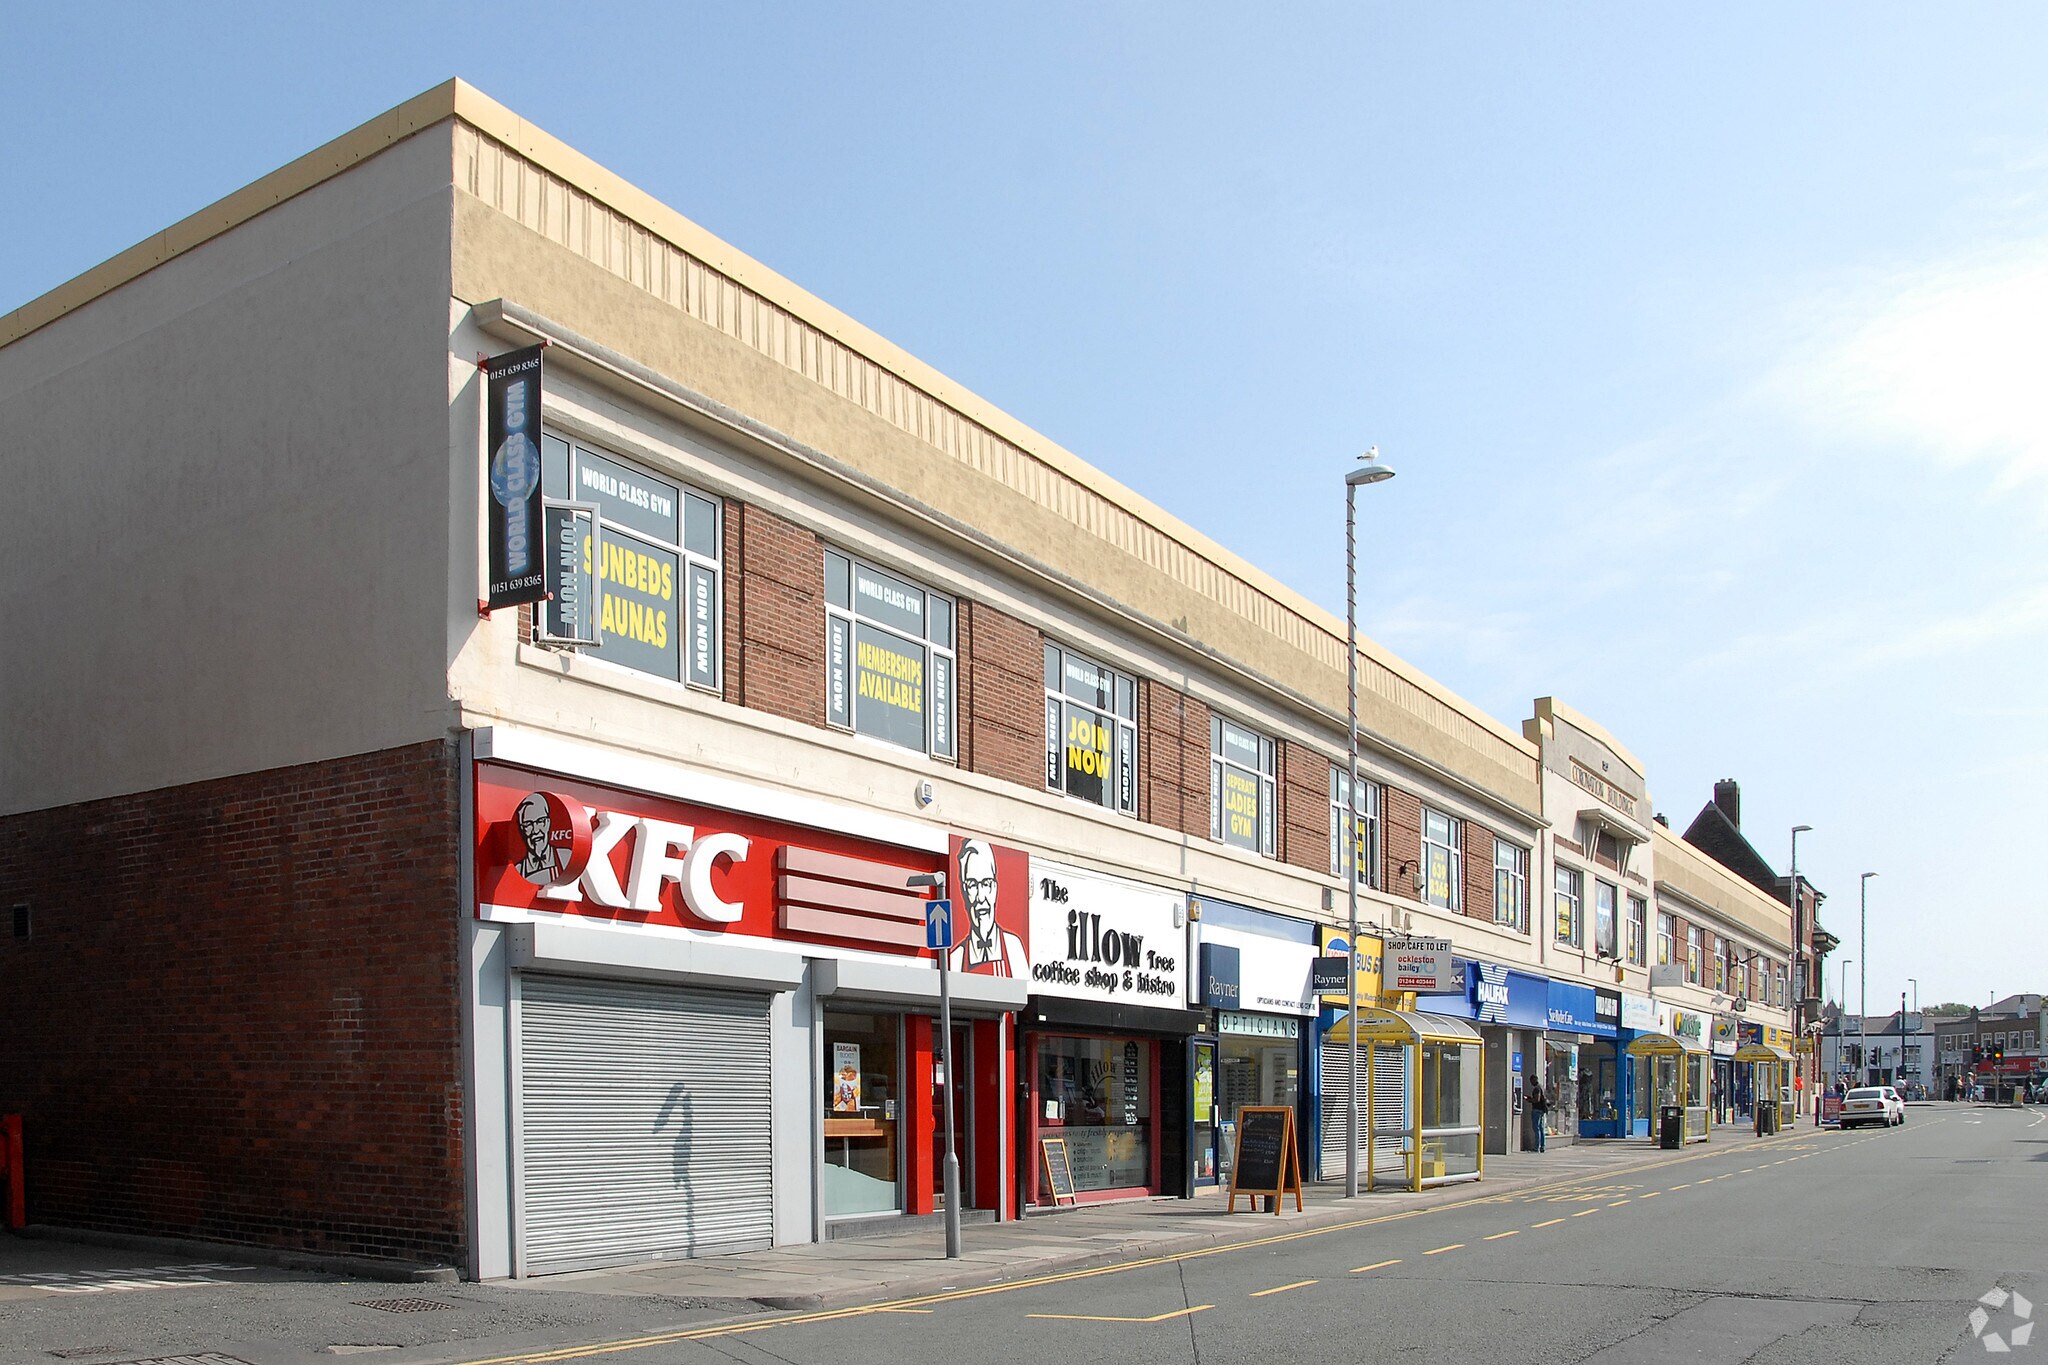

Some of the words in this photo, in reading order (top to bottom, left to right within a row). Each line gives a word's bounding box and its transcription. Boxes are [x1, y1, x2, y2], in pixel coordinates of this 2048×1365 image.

[490, 368, 506, 381] 0151
[507, 364, 521, 375] 639
[522, 359, 539, 371] 8365
[507, 381, 525, 428] GYM
[507, 432, 525, 492] CLASS
[582, 466, 617, 497] WORLD
[619, 481, 649, 509] CLASS
[651, 494, 671, 518] GYM
[508, 496, 526, 572] WORLD
[561, 518, 576, 568] JOIN
[491, 580, 508, 594] 0151
[509, 578, 522, 590] 639
[524, 574, 541, 587] 8365
[583, 534, 672, 600] SUNBEDS
[561, 571, 577, 625] NOW
[697, 575, 708, 616] JOIN
[858, 577, 883, 601] WORLD
[884, 587, 904, 610] CLASS
[905, 595, 920, 616] GYM
[590, 593, 667, 649] AUNAS
[697, 623, 708, 673] NOW
[834, 624, 843, 662] JOIN
[858, 641, 922, 687] MEMBERSHIPS
[936, 663, 945, 698] JOIN
[834, 667, 843, 714] NOW
[858, 671, 921, 713] AVAILABLE
[936, 702, 945, 744] NOW
[1068, 717, 1110, 753] JOIN
[1069, 744, 1111, 780] NOW
[1226, 772, 1256, 796] SEPERATE
[1225, 788, 1257, 818] LADIES
[551, 829, 573, 841] KFC
[1231, 813, 1252, 838] GYM
[537, 806, 750, 923] KFC
[1431, 862, 1446, 880] 639
[1040, 878, 1069, 904] The
[1066, 909, 1144, 969] illow
[1426, 942, 1435, 951] TO
[1436, 943, 1448, 951] LET
[1146, 949, 1175, 973] Tree
[1356, 953, 1373, 973] BUS
[1398, 955, 1435, 964] ockleston
[1398, 964, 1420, 974] bailey
[1084, 966, 1118, 994] shop
[1122, 970, 1133, 991] &
[1137, 972, 1176, 997] bistro
[1209, 976, 1239, 1000] Rayner
[1314, 974, 1346, 987] Rayner
[1478, 981, 1509, 1006] HALIFAX
[1222, 1014, 1297, 1036] OPTICIANS
